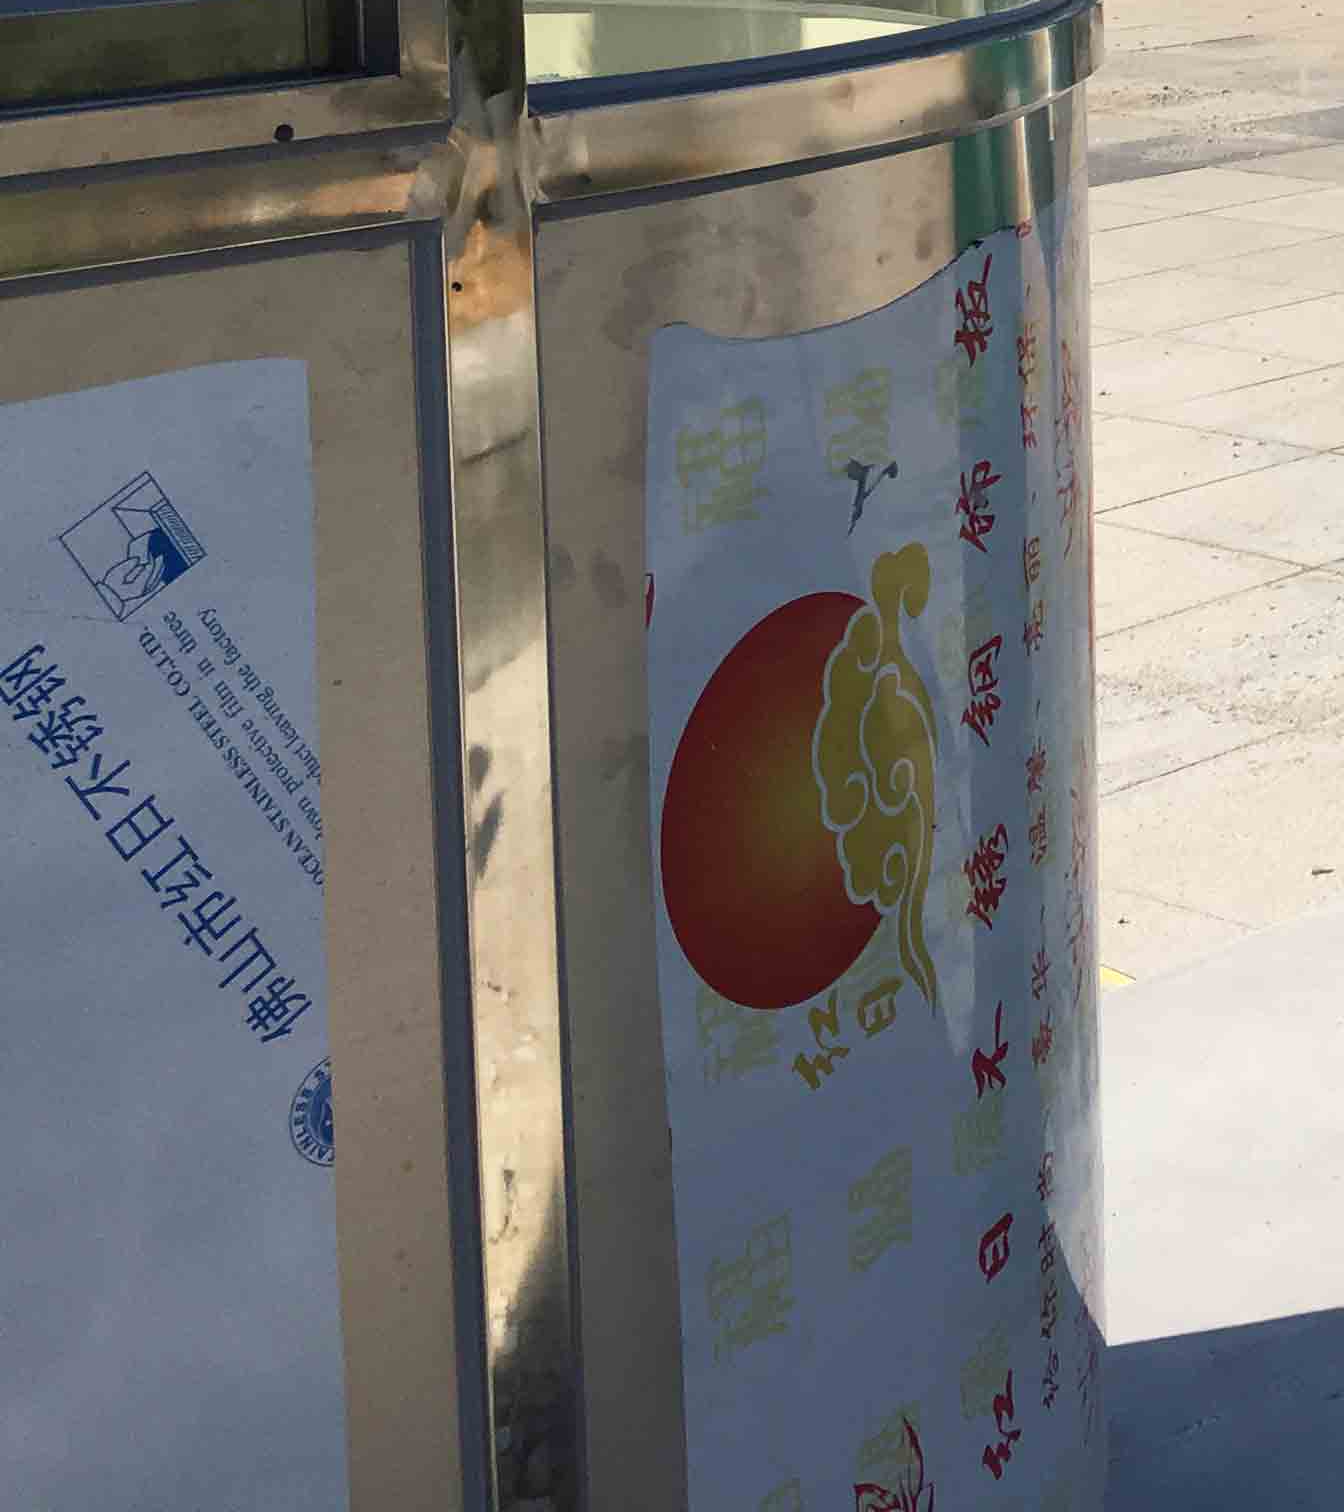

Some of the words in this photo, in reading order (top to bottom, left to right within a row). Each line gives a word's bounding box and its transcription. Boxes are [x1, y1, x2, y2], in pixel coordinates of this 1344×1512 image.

[164, 612, 197, 654] three
[198, 609, 241, 665] factory
[197, 658, 215, 680] in
[238, 664, 261, 691] the
[188, 696, 230, 749] STEEL
[214, 681, 244, 718] film
[256, 687, 299, 748] leaving
[242, 720, 304, 794] protective
[293, 744, 323, 785] duct
[222, 747, 290, 832] STAINLESS
[0, 645, 312, 1043] 佛山市红日不锈钢
